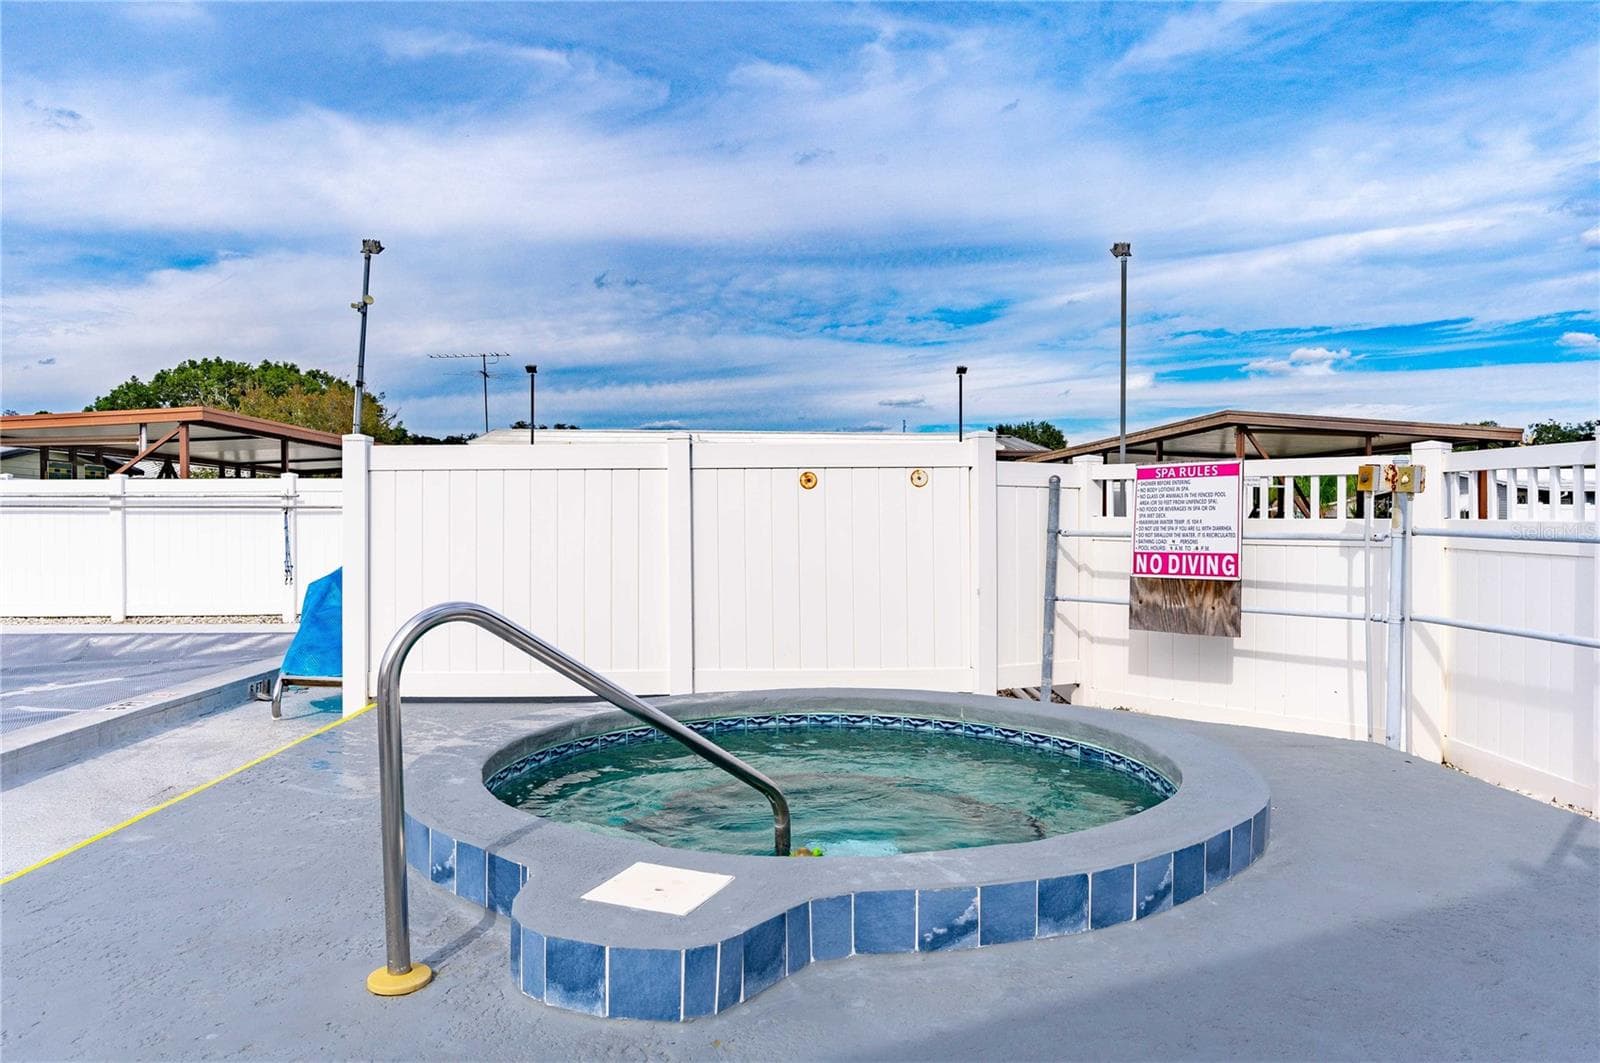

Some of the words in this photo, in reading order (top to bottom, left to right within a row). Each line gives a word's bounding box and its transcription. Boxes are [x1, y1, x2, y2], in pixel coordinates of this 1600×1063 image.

[1155, 467, 1176, 478] SPA
[1179, 465, 1218, 477] RULES
[1136, 554, 1163, 574] NO
[1168, 554, 1236, 576] DIVING
